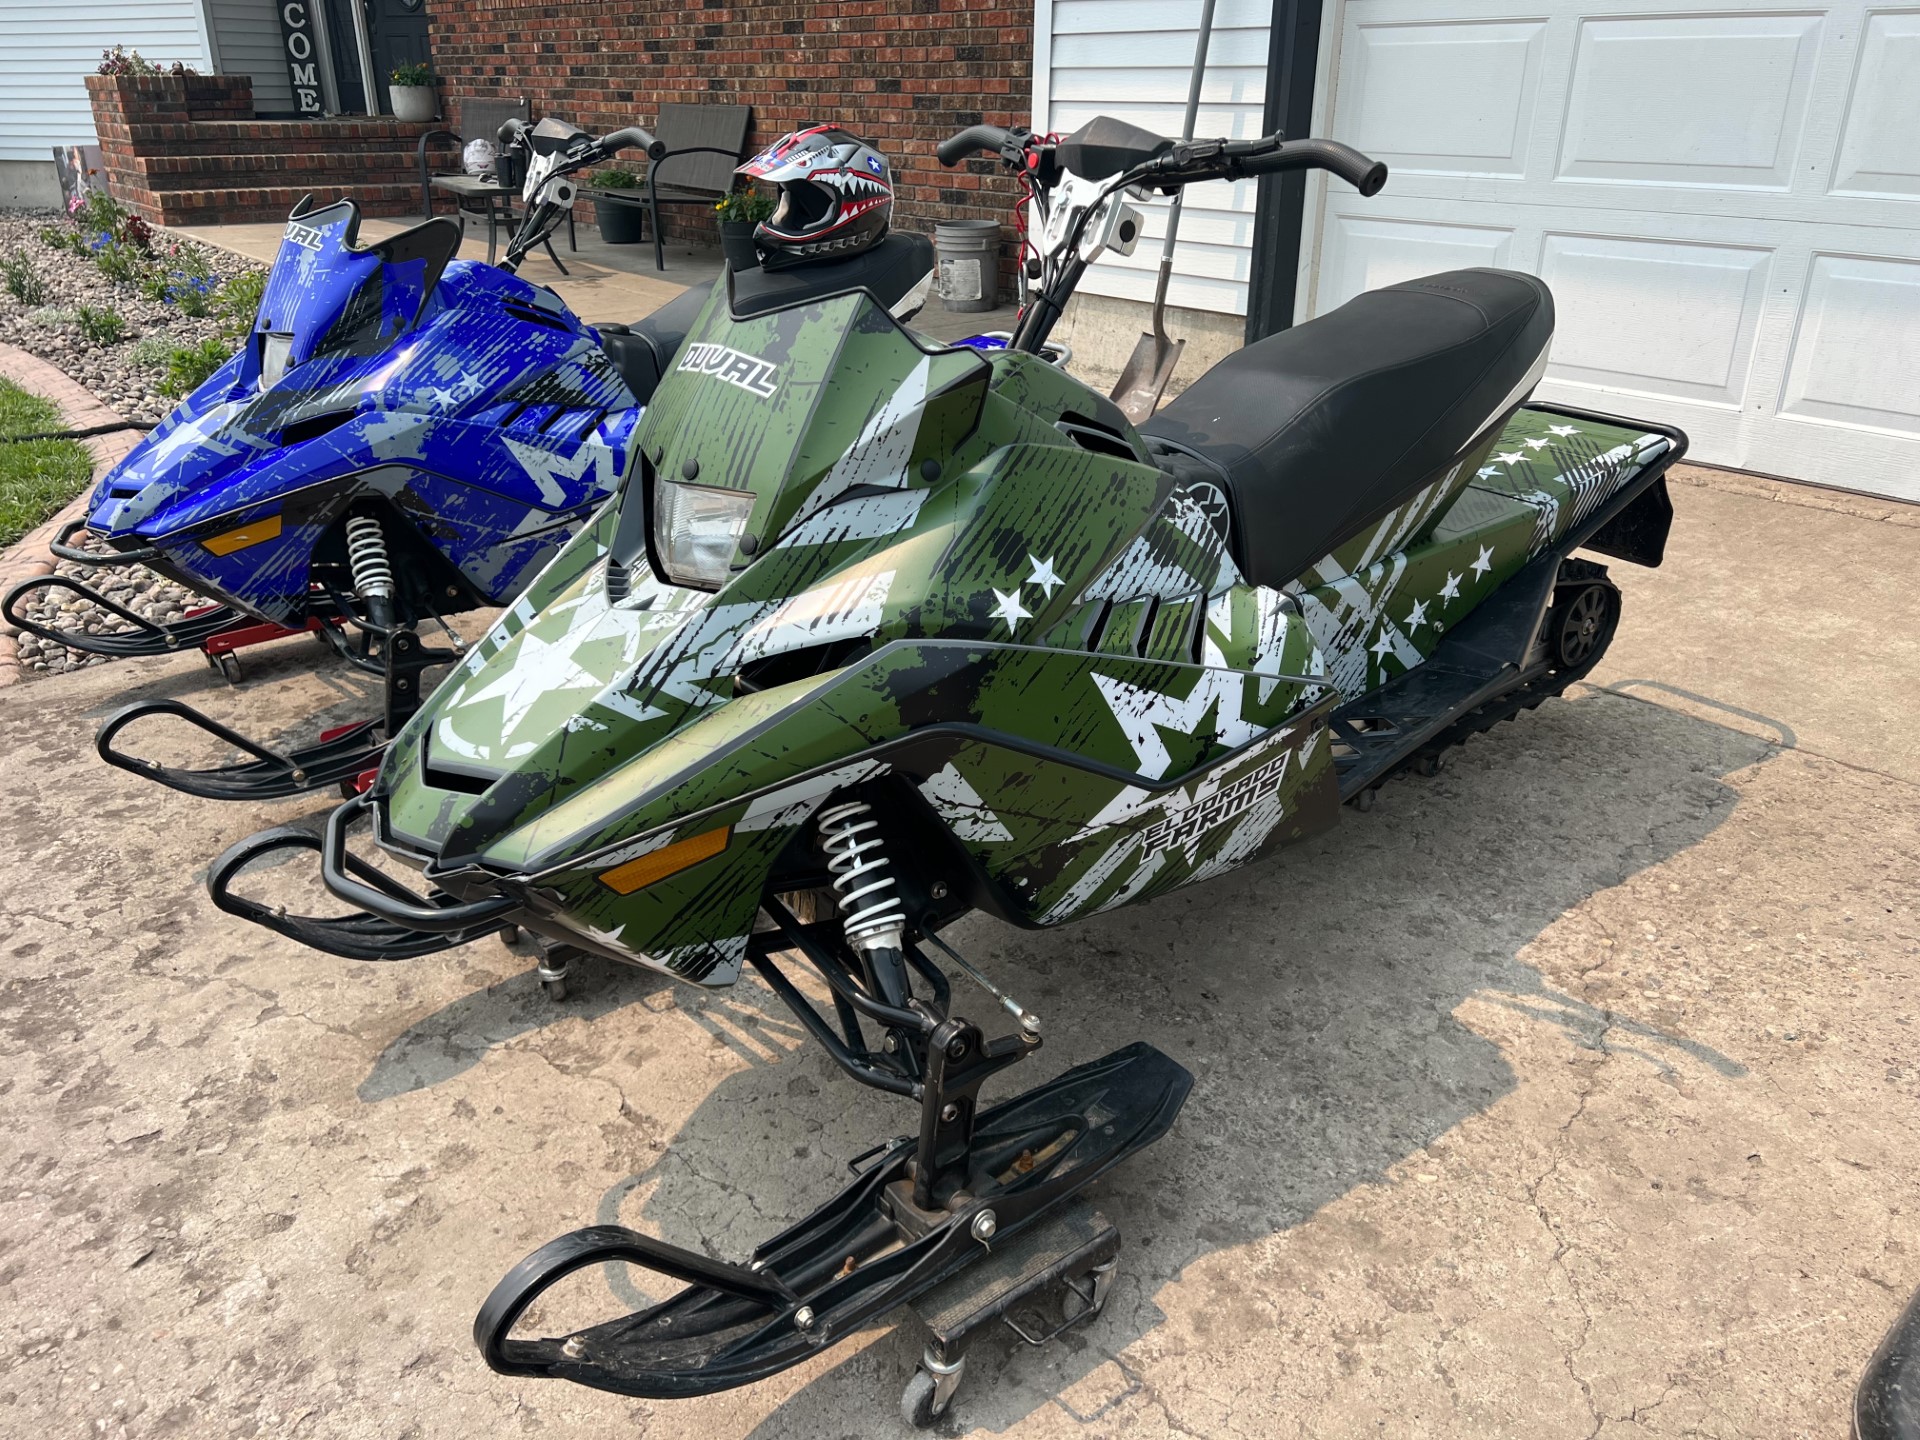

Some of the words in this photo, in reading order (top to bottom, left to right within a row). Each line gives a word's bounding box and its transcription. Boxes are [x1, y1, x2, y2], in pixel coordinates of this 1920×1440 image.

[283, 2, 320, 112] COME
[1142, 767, 1282, 860] FARMS
[1144, 817, 1179, 842] EL
[1181, 752, 1286, 824] DORADO
